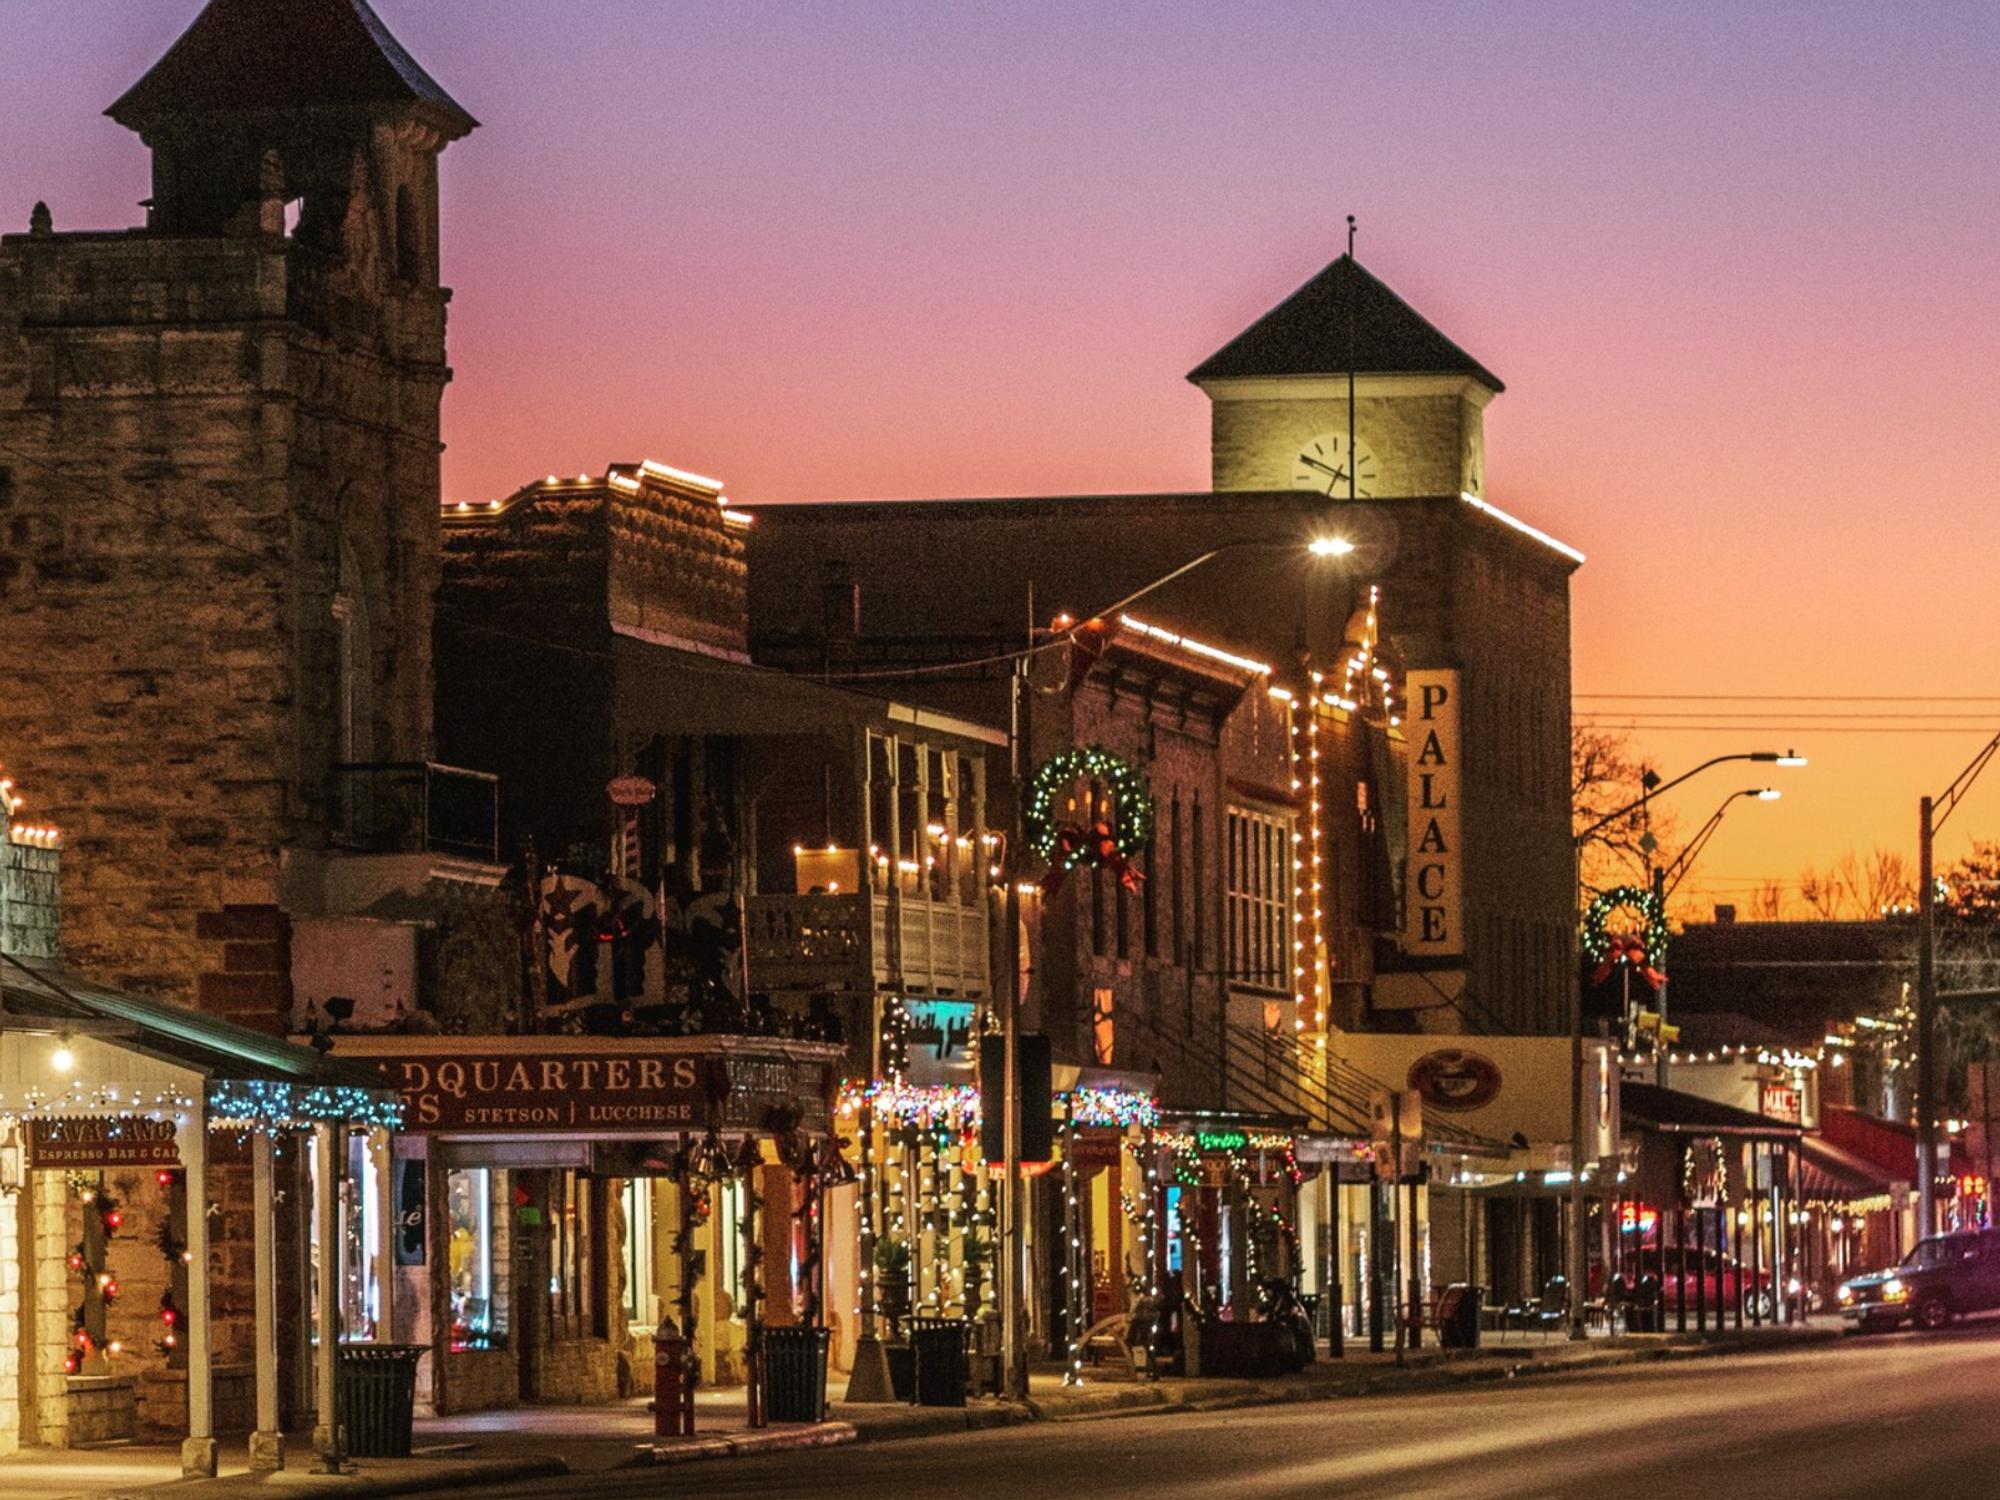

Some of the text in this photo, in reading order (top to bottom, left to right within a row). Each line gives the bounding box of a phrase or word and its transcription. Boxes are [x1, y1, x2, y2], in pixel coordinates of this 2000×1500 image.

[1417, 684, 1448, 942] PALACE
[379, 1059, 696, 1098] DQUARTERS
[465, 1107, 560, 1122] STETSON
[589, 1105, 691, 1121] LUCCHESE
